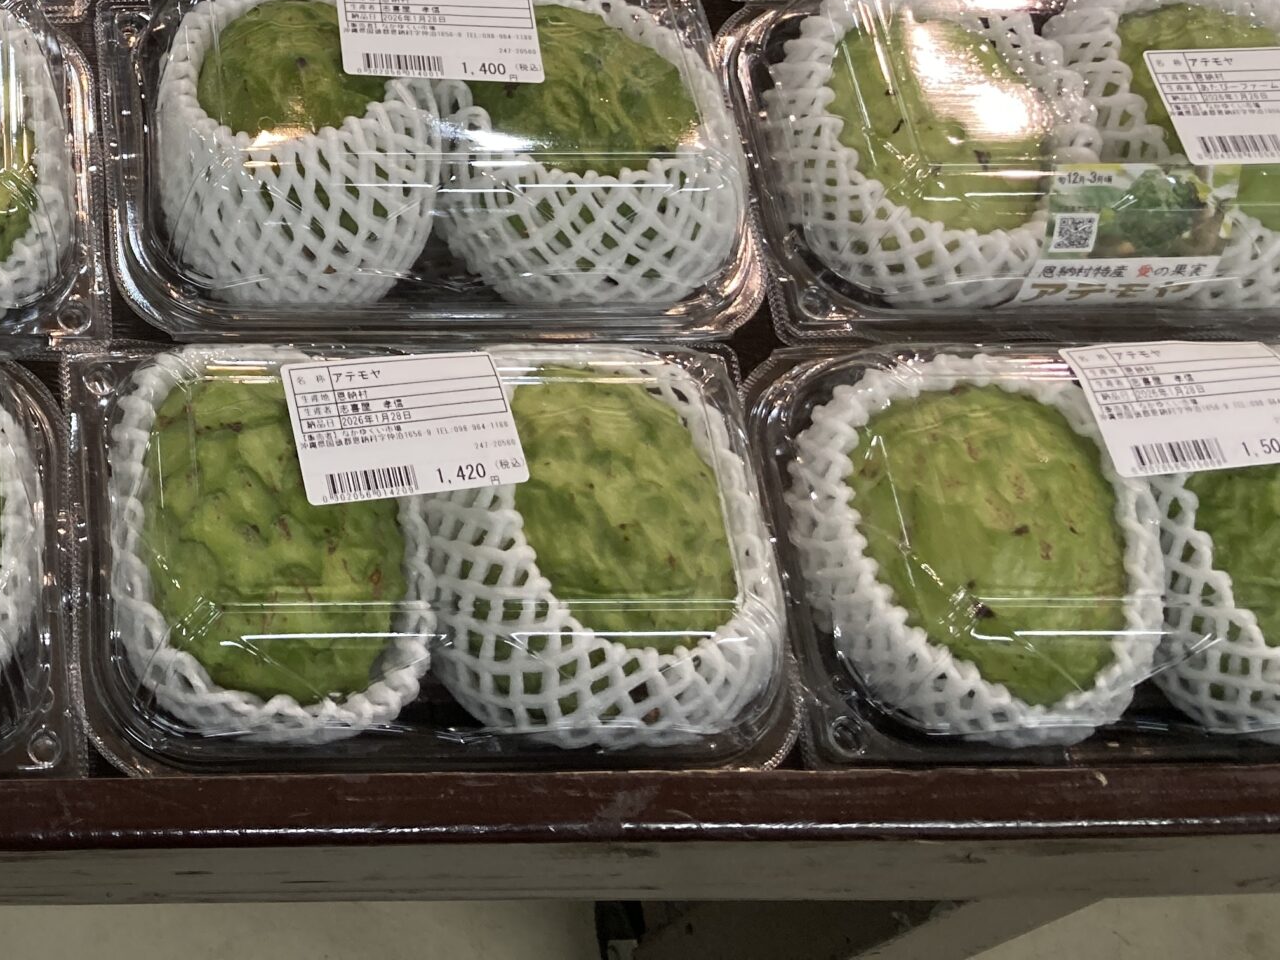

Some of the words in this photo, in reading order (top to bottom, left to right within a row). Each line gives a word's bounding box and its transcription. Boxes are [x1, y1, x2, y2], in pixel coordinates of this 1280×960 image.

[460, 61, 507, 77] 1,400
[1040, 265, 1129, 278] 恩納村特産
[1136, 264, 1207, 278] 愛の果実
[332, 370, 384, 384] アテモヤ
[336, 390, 370, 402] 恩納村
[340, 411, 413, 426] 2026年1月28日
[435, 463, 489, 485] 1,420
